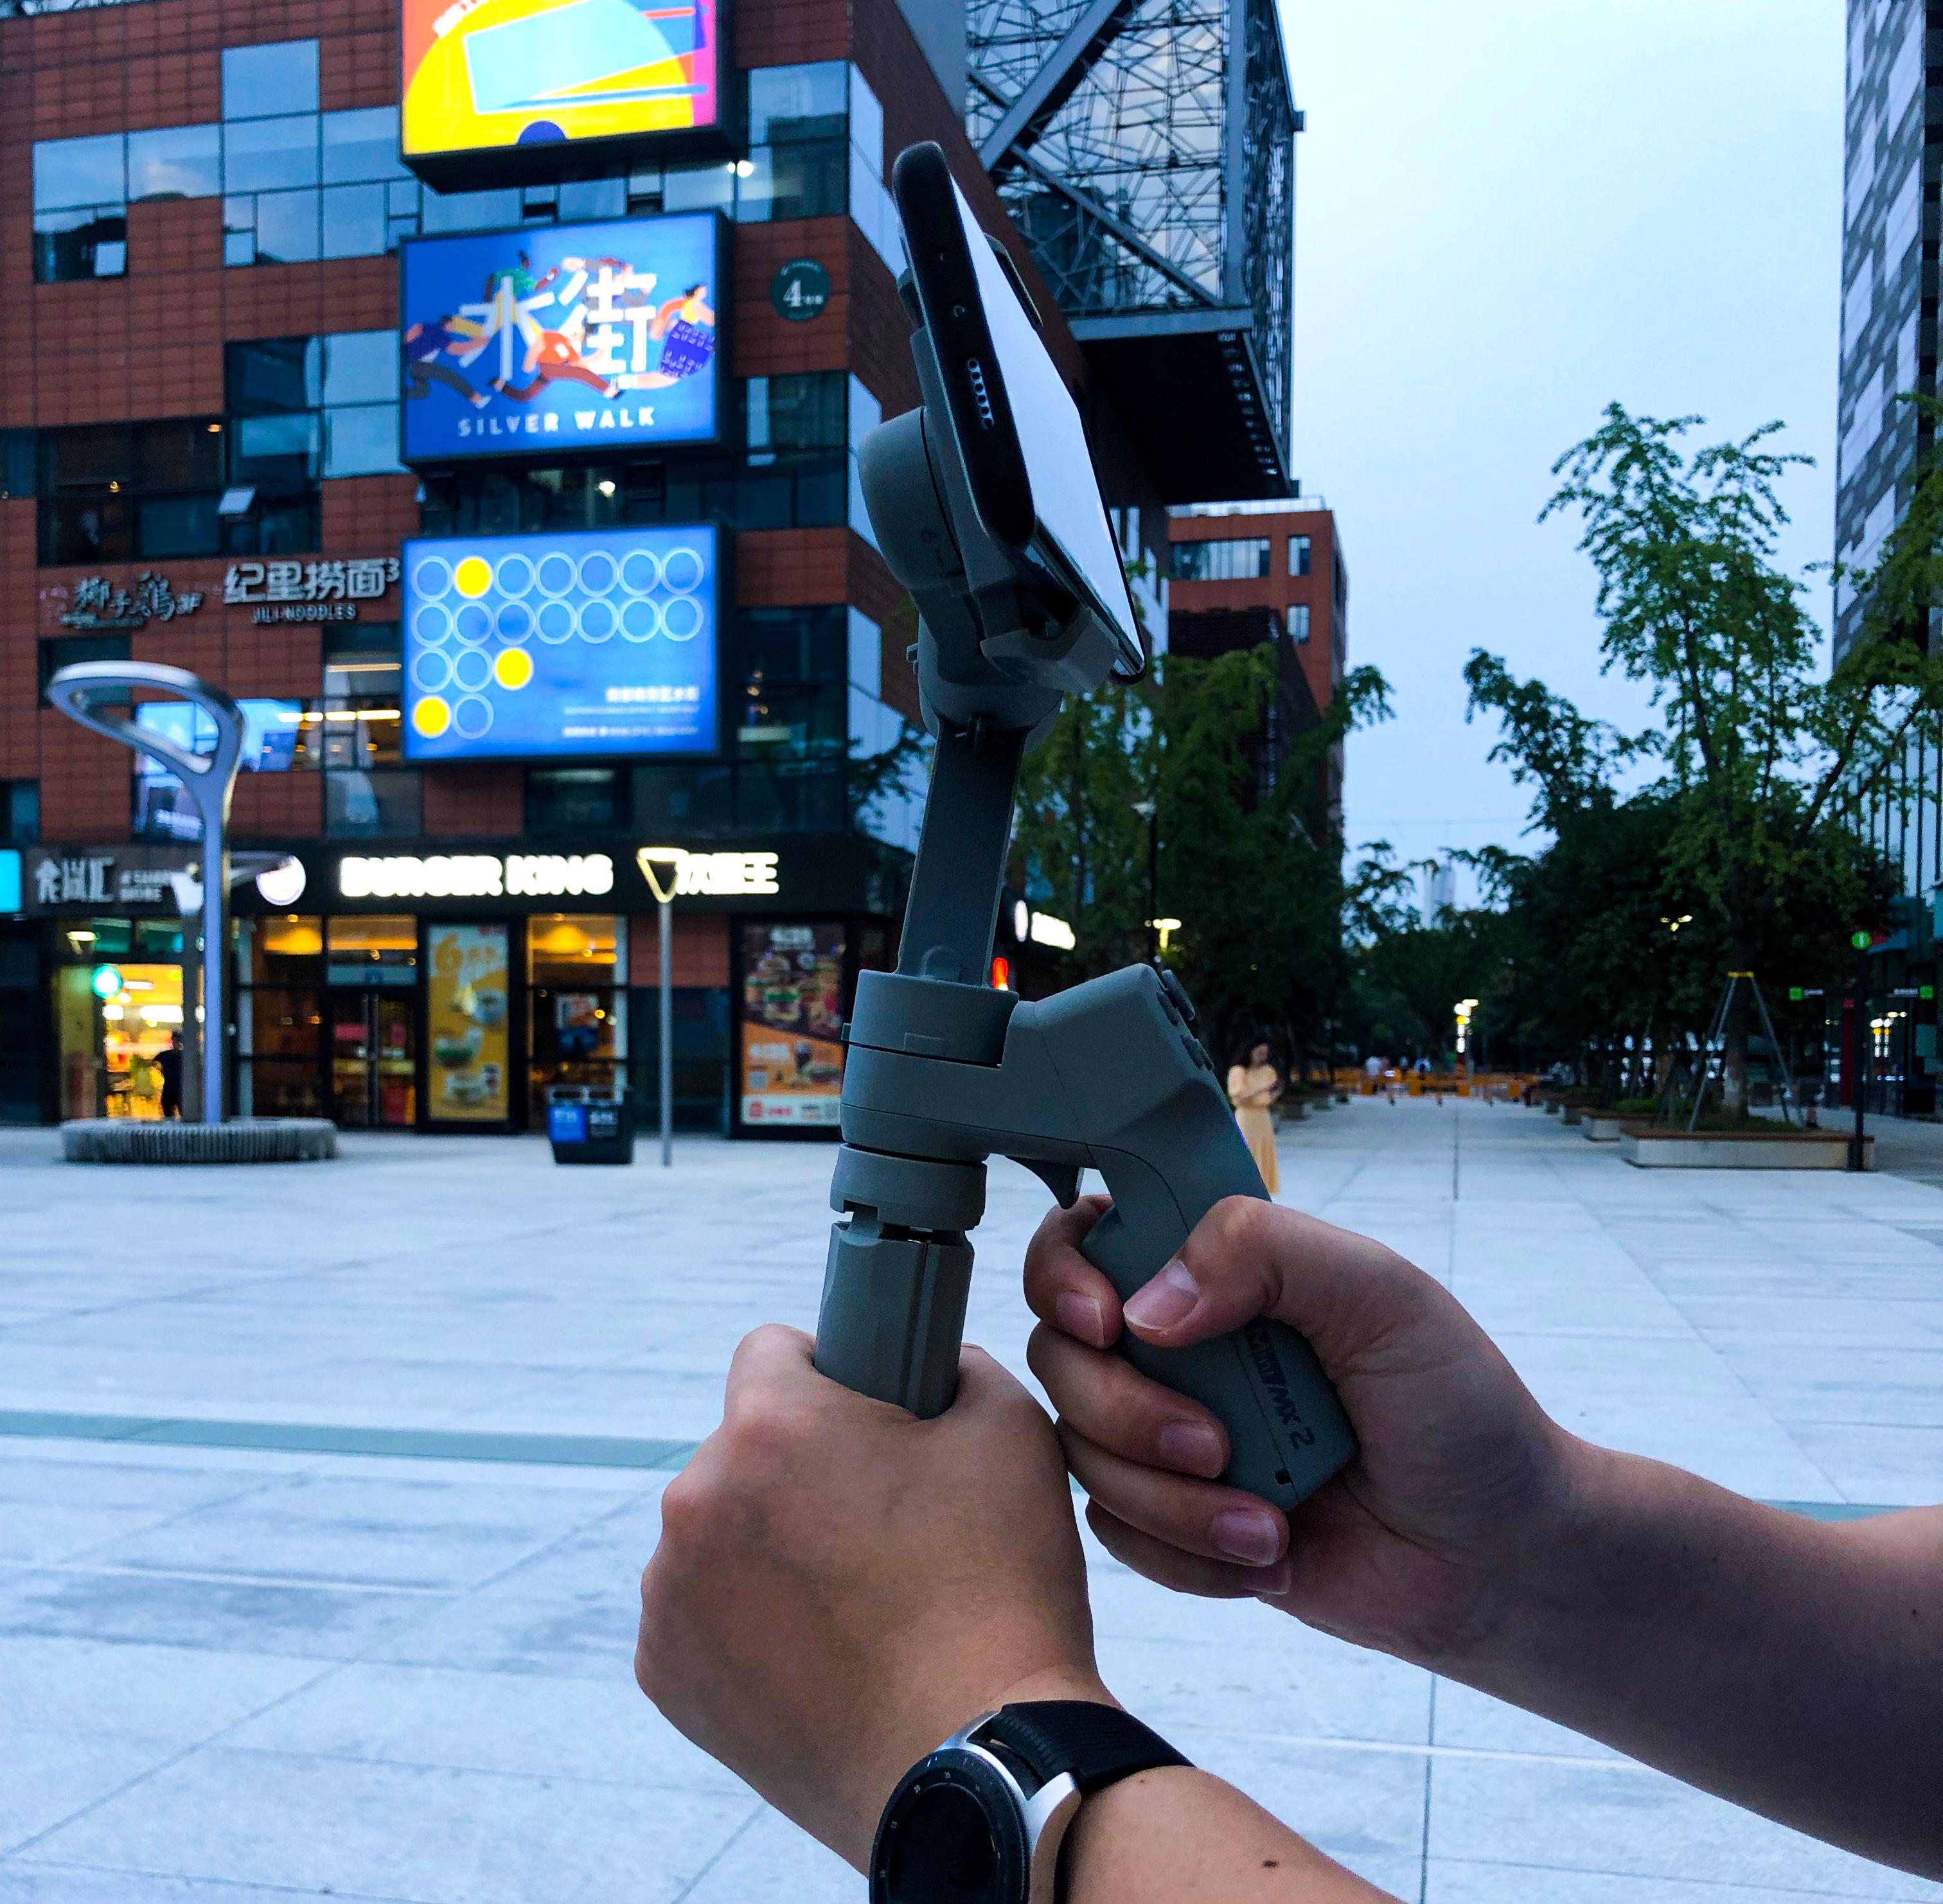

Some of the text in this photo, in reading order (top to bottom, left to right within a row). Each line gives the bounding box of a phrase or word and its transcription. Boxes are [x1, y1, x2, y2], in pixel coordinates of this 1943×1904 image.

[782, 278, 801, 307] 4
[457, 406, 655, 437] SILVER WALK
[1289, 1427, 1315, 1450] 2
